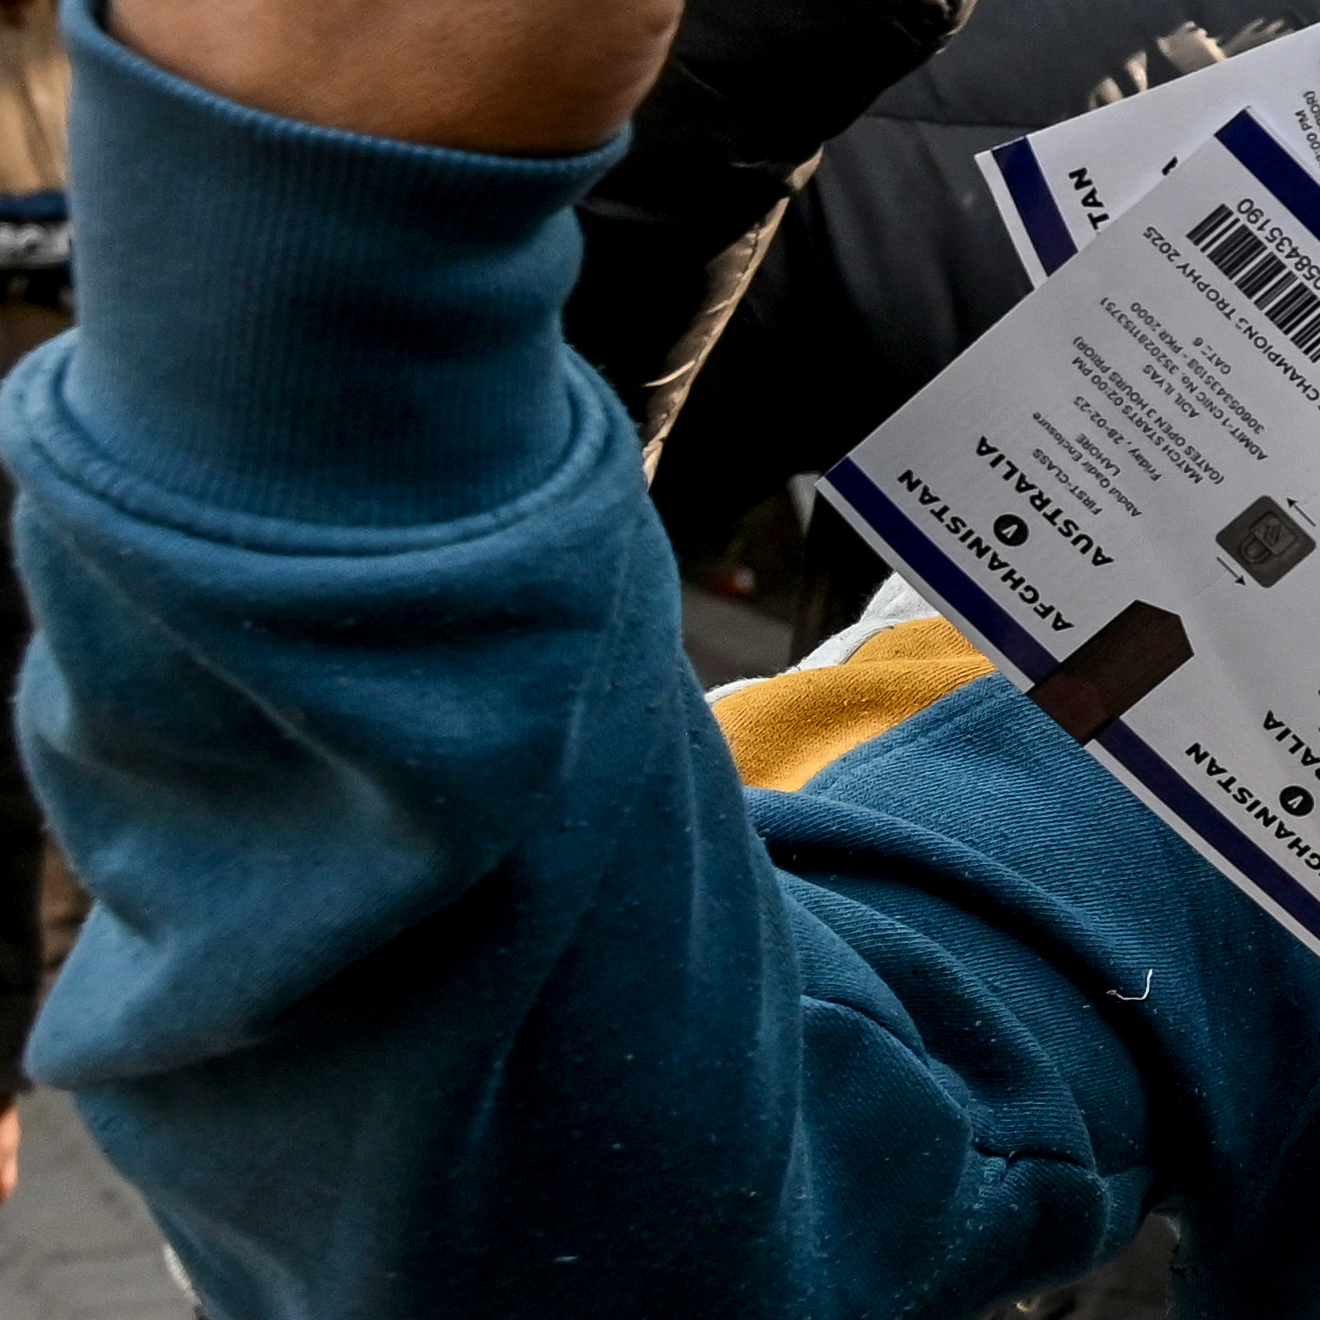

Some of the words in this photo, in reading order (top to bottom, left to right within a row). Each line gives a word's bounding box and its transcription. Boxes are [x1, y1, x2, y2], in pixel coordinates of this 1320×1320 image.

[1294, 109, 1314, 132] PM
[1142, 226, 1181, 263] 2025
[1175, 262, 1237, 321] TROPHY
[1072, 335, 1112, 374] PRIOR)
[1191, 336, 1204, 348] 6
[1234, 317, 1320, 402] CHAMPIONS
[1071, 356, 1094, 377] PM
[1142, 364, 1176, 396] ILYAS
[1180, 372, 1199, 394] No.
[1090, 374, 1125, 407] 02:00
[1108, 371, 1150, 412] HOURS
[1194, 391, 1225, 420] CNIC
[1032, 411, 1084, 463] Enclosure
[1121, 404, 1166, 447] STARTS
[1153, 416, 1187, 448] OPEN
[1220, 417, 1269, 461] ADMIT-1
[1075, 432, 1121, 478] LAHORE
[1080, 460, 1111, 489] Qadir
[1127, 448, 1163, 482] Friday
[1161, 443, 1204, 485] MATCH
[1183, 445, 1225, 486] (GATES
[975, 435, 1115, 567] AUSTRALIA
[1031, 448, 1103, 516] FIRST-CLASS
[1107, 486, 1143, 518] Abdul
[896, 469, 1075, 632] AFGHANISTAN
